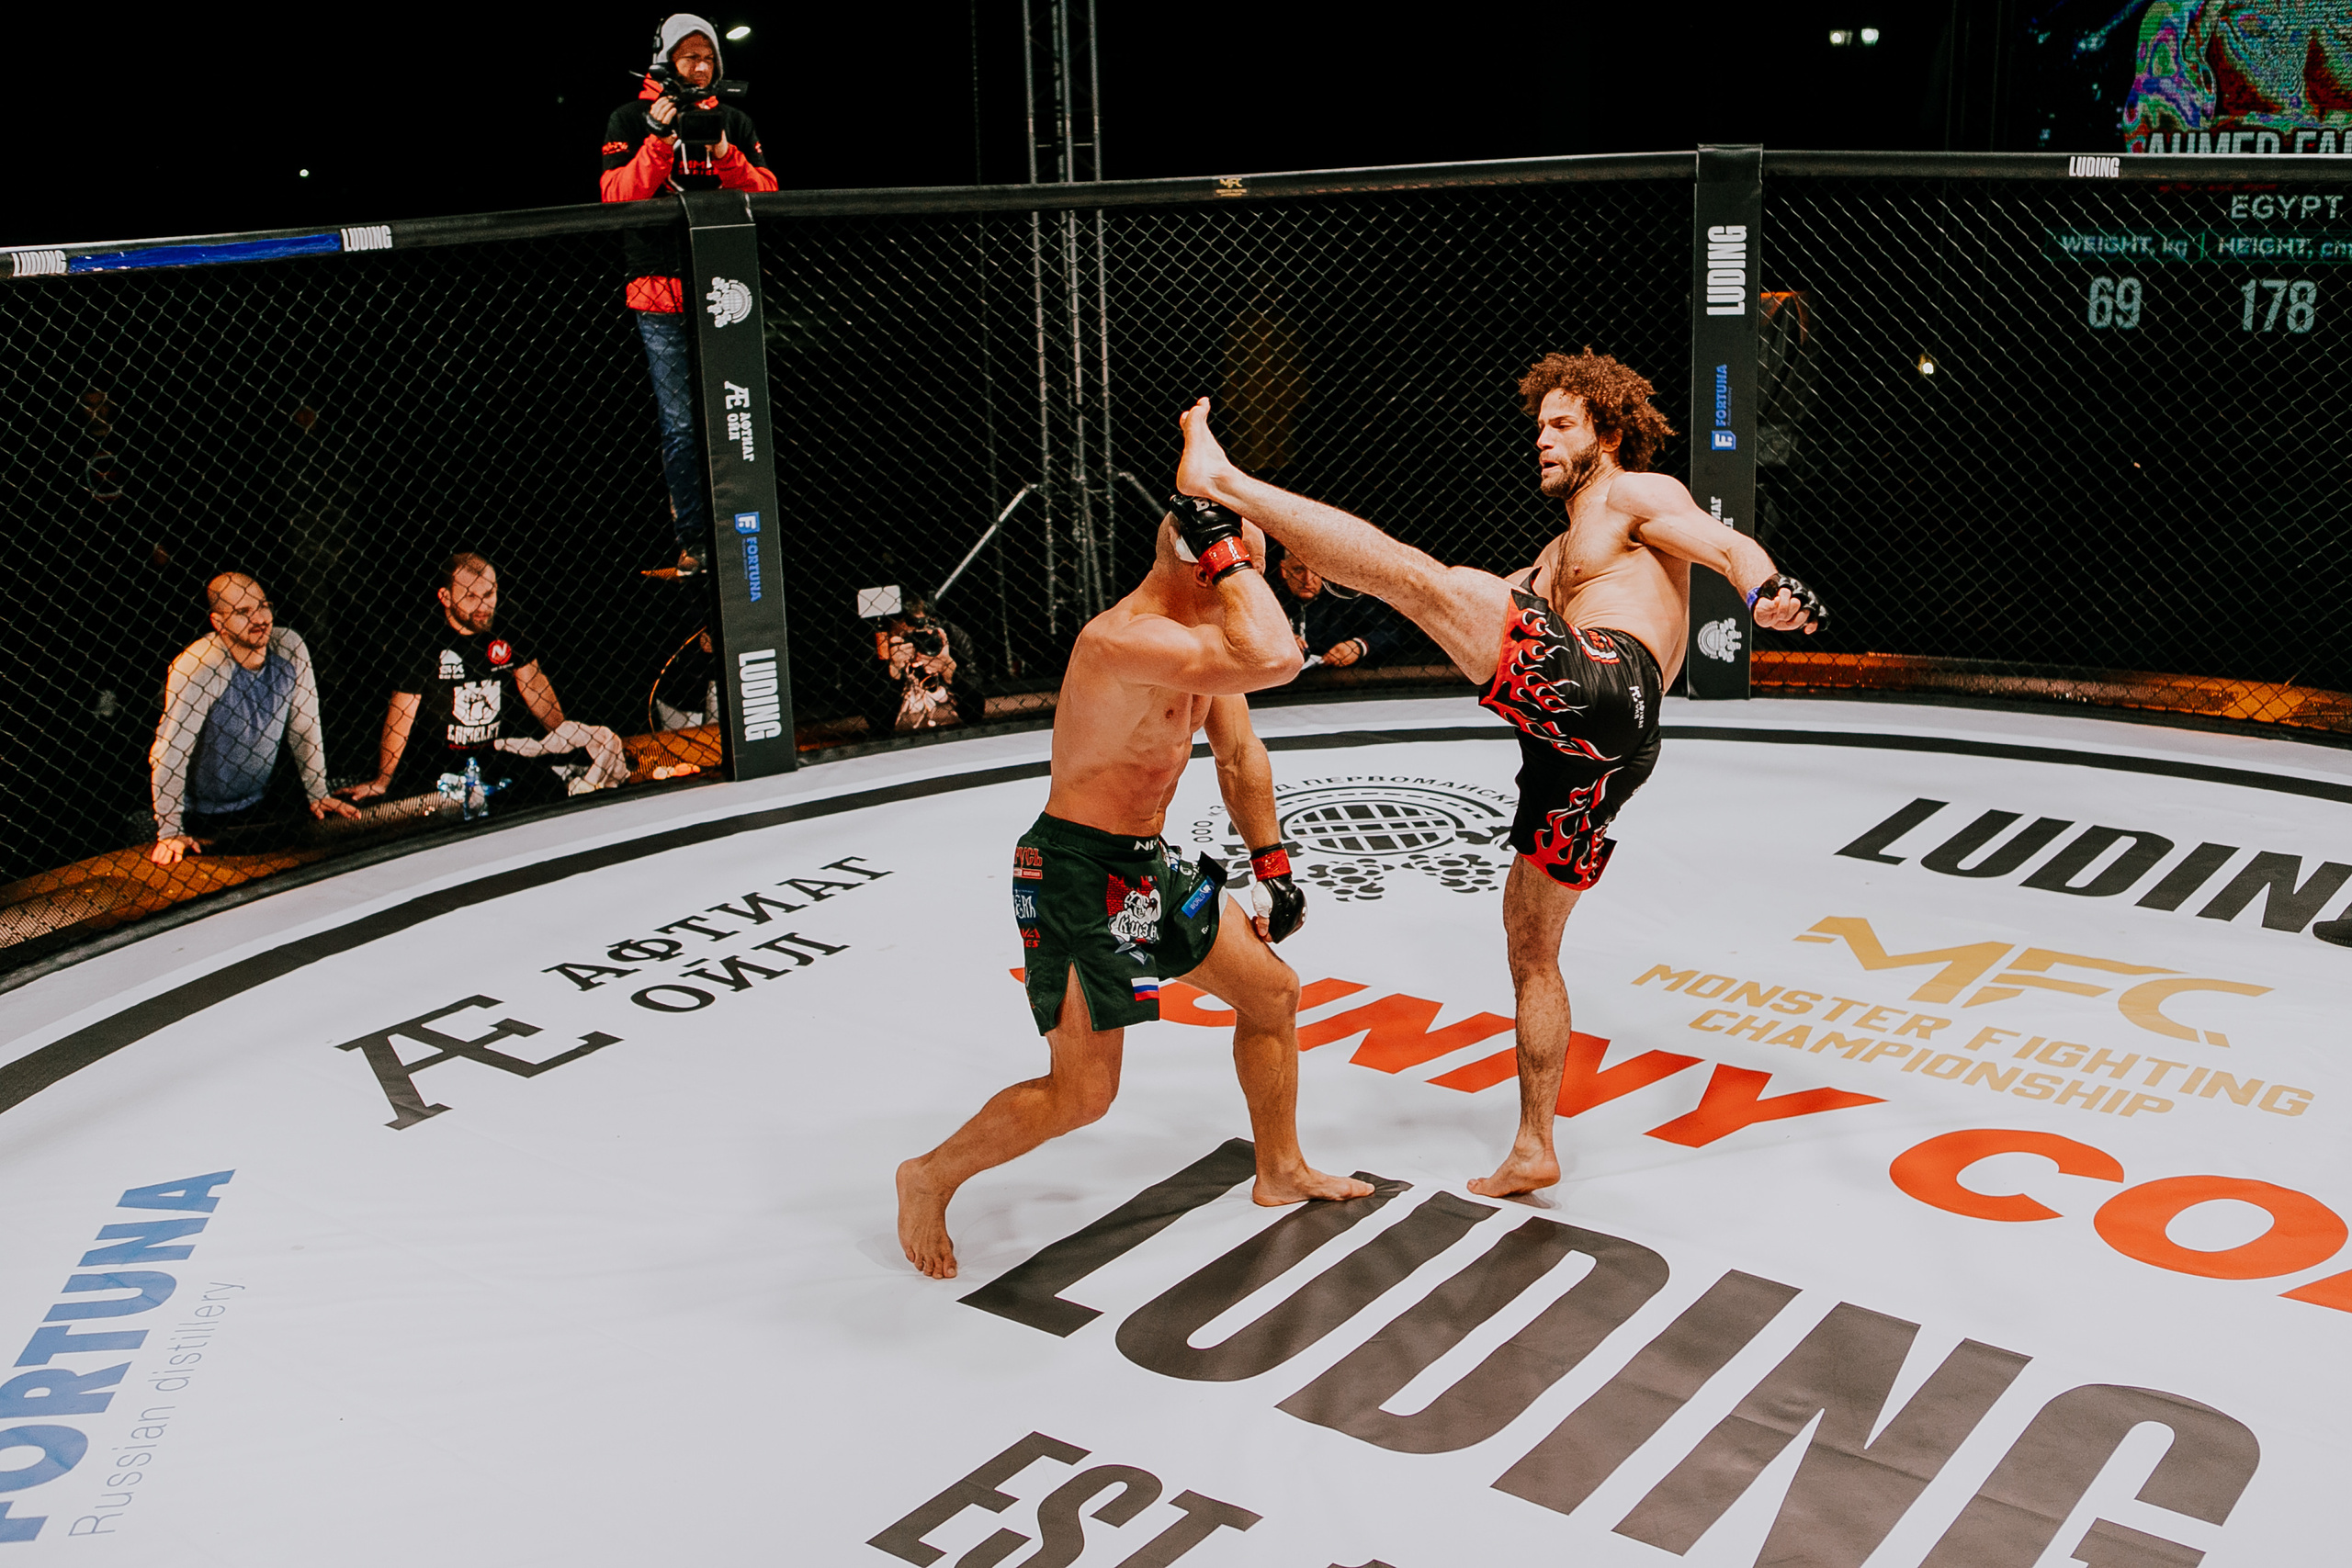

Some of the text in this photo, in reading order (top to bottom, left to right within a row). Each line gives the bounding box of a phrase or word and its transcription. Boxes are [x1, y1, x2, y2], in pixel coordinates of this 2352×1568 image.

[2069, 156, 2120, 177] LUDING
[2231, 195, 2343, 219] EGYPT
[12, 250, 67, 276] LUDING
[342, 225, 392, 252] LUDING
[1707, 225, 1747, 316] LUDING
[2087, 276, 2143, 329] 69
[2240, 279, 2318, 333] 178
[1715, 364, 1728, 426] FORTUNA
[746, 536, 762, 603] FORTUNA
[739, 649, 782, 741] LUDING
[1834, 797, 2352, 933] LUDIN
[540, 856, 894, 992] АФТИАГ
[630, 932, 851, 1013] ОЙЛ
[1792, 915, 2275, 1048] MFC
[1631, 964, 2315, 1117] MONSTER FIGHTING
[1689, 1009, 2175, 1118] CHAMPIONSHIP
[1889, 1129, 2352, 1314] CO
[956, 1138, 2261, 1568] LUDING
[68, 1281, 245, 1537] Russian distillery
